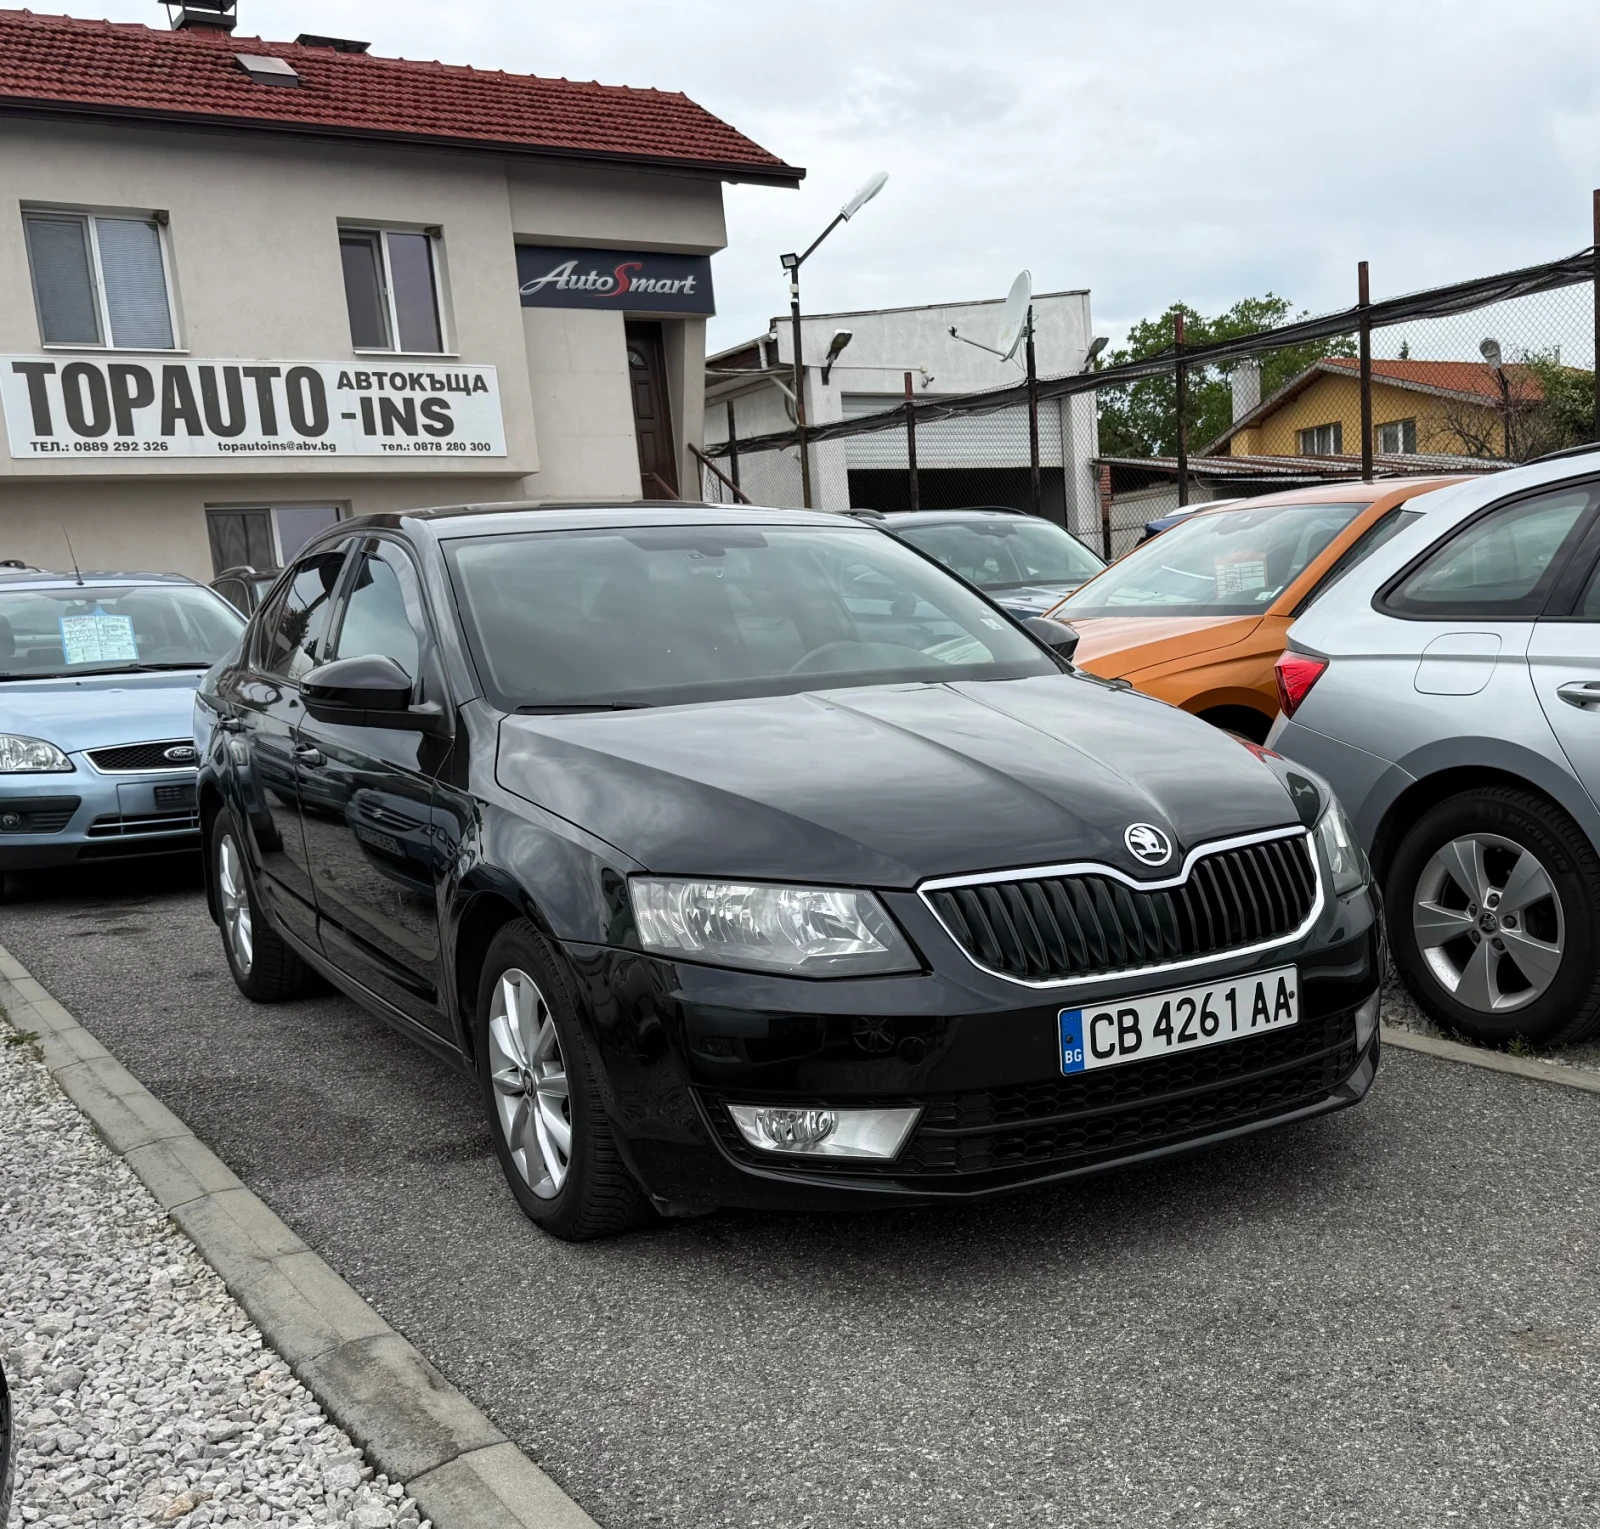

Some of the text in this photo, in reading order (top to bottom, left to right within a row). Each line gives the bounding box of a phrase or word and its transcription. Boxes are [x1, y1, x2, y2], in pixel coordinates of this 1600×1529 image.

[519, 260, 697, 297] AutoSmart
[336, 371, 489, 395] АВТОКЪЩА
[12, 362, 330, 438] TOPAUTO
[341, 397, 455, 437] -INS
[30, 441, 169, 452] ТЕЛ.: 0889 292 326
[217, 440, 337, 453] topautoins@abv.bg
[381, 442, 492, 452] тел.: 0878 280 300
[173, 748, 193, 757] Ford
[1089, 976, 1293, 1059] CB 4261 AA
[1064, 1048, 1083, 1064] BG
